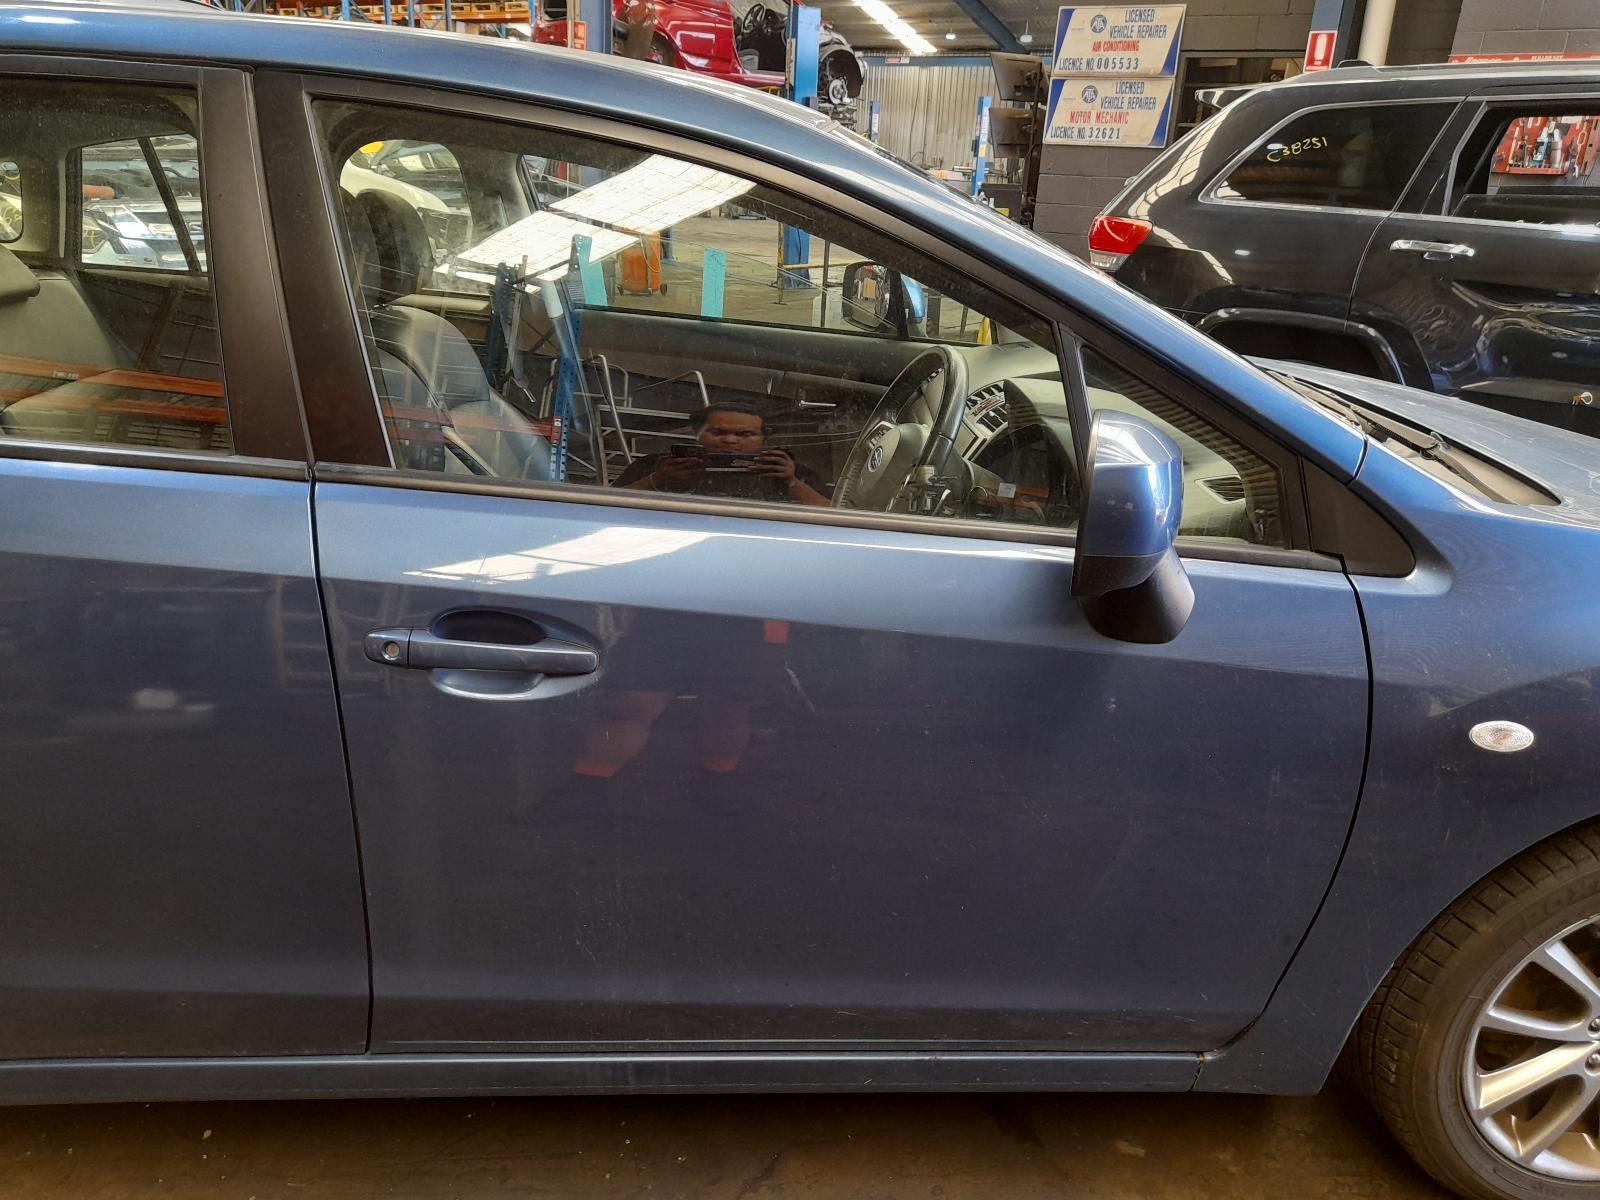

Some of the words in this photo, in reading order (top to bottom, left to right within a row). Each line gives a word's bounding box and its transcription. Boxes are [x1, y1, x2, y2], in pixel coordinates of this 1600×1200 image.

[1125, 9, 1155, 23] LICENSED
[1110, 25, 1134, 38] VEHICLE
[1137, 25, 1167, 38] REPAIRER
[1092, 41, 1101, 52] AIR
[1103, 40, 1140, 52] CONDITIONING
[1059, 58, 1083, 71] LICENCE
[1115, 81, 1144, 94] LICENSED
[1101, 96, 1125, 109] VEHICLE
[1127, 97, 1157, 110] REPAIRER
[1069, 111, 1091, 124] MOTOR
[1095, 112, 1130, 124] MECHANIC
[1051, 126, 1075, 139] LICENCE
[1266, 136, 1328, 162] C38251
